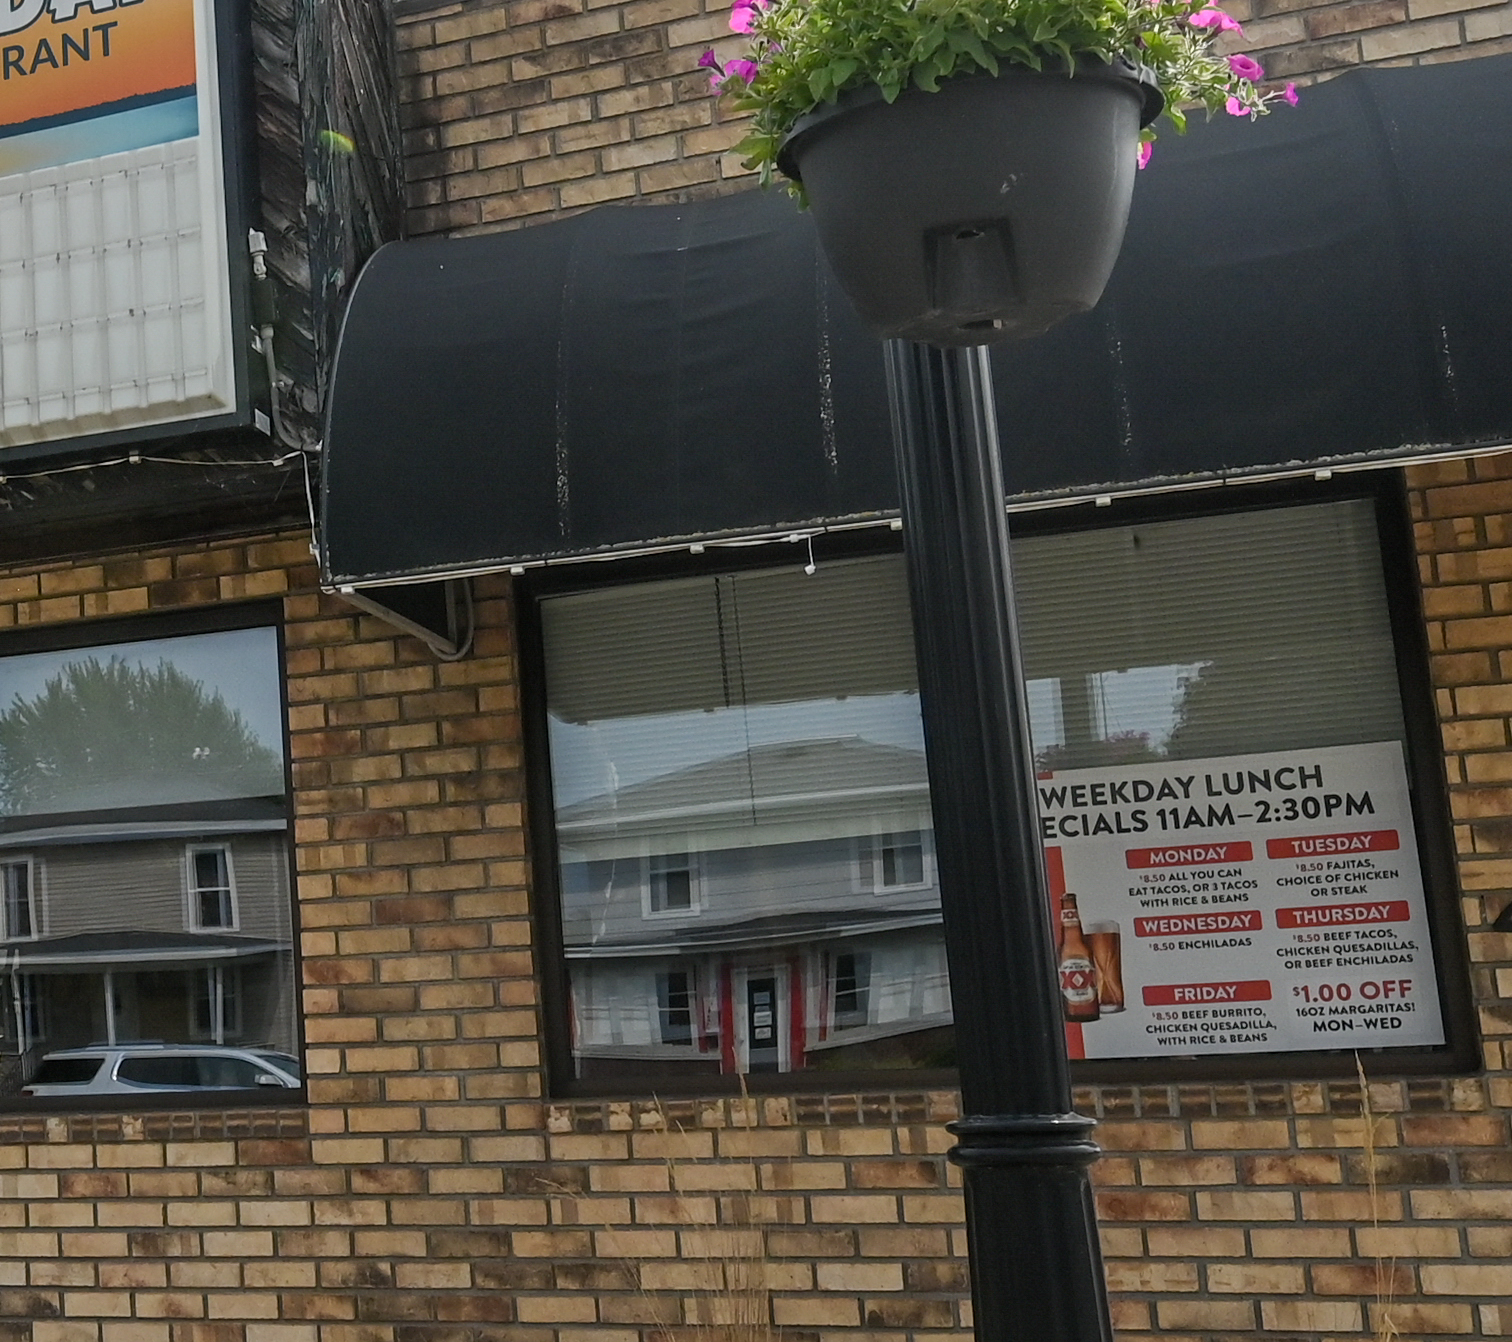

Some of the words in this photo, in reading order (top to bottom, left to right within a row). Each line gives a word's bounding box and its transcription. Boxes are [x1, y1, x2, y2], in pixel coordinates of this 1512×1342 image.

[1039, 775, 1195, 810] WEEKDAY
[1205, 764, 1323, 797] LUNCH
[1041, 809, 1149, 839] ECIALS
[1291, 835, 1372, 853] TUESDAY
[1150, 846, 1227, 864] MONDAY
[1327, 858, 1375, 870] FAJITAS,
[1168, 872, 1188, 882] ALL
[1190, 870, 1214, 880] YOU
[1217, 867, 1242, 878] CAN
[1276, 875, 1322, 886] CHOICE
[1325, 874, 1341, 884] OF
[1344, 870, 1399, 882] CHICKEN
[1129, 886, 1148, 896] EAT
[1150, 885, 1191, 895] TACOS,
[1192, 883, 1209, 893] OR
[1221, 880, 1258, 890] TACOS
[1311, 888, 1328, 897] OR
[1331, 885, 1367, 896] STEAK
[1140, 898, 1169, 908] WITH
[1172, 896, 1198, 906] RICE
[1201, 895, 1209, 904] &
[1212, 893, 1249, 904] BEANS
[1293, 905, 1390, 924] THURSDAY
[1142, 914, 1252, 933] WEDNESDAY
[1323, 931, 1352, 942] BEEF
[1354, 929, 1398, 940] TACOS,
[1178, 938, 1252, 950] ENCHILADAS
[1276, 945, 1329, 957] CHICKEN
[1333, 940, 1419, 956] QUESADILLAS,
[1284, 960, 1302, 969] OR
[1305, 958, 1333, 969] BEEF
[1336, 954, 1414, 967] ENCHILADAS
[1174, 985, 1237, 1001] FRIDAY
[1292, 982, 1352, 1003] $1.00
[1359, 979, 1412, 1000] OFF
[1182, 1010, 1209, 1019] BEEF
[1212, 1007, 1267, 1018] BURRITO,
[1328, 1002, 1416, 1016] MARGARITAS!
[1145, 1022, 1198, 1034] CHICKEN
[1200, 1020, 1277, 1033] QUESADILLA,
[1157, 1036, 1187, 1046] WITH
[1189, 1035, 1216, 1045] RICE
[1219, 1034, 1227, 1043] &
[1230, 1032, 1268, 1043] BEANS
